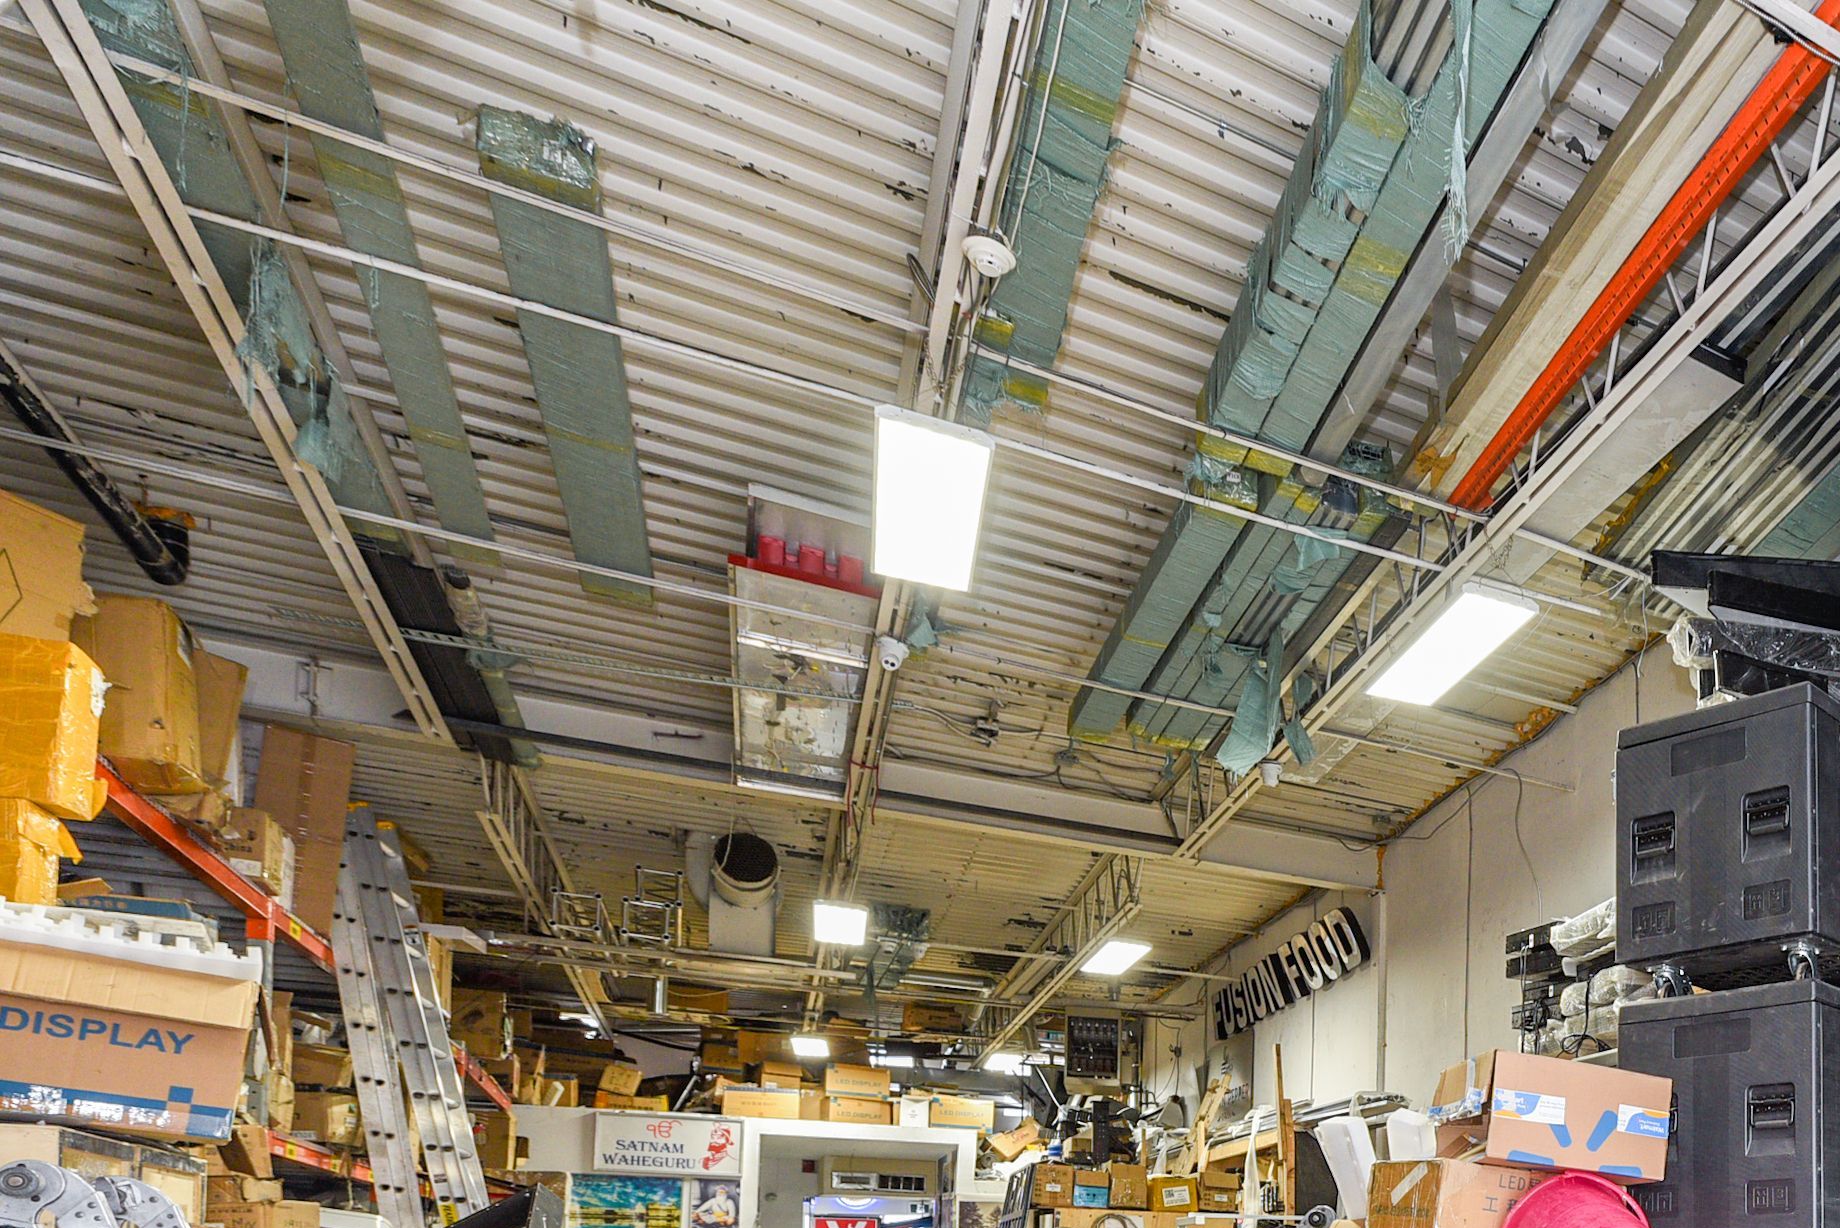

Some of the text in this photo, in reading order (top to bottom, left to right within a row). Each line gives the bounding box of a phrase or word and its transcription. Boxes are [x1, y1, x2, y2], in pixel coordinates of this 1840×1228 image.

[1212, 907, 1368, 1040] FUSION FOOD
[0, 1006, 194, 1055] DISPLAY
[602, 1153, 697, 1170] WAHEGURU
[615, 1139, 685, 1154] SATNAM
